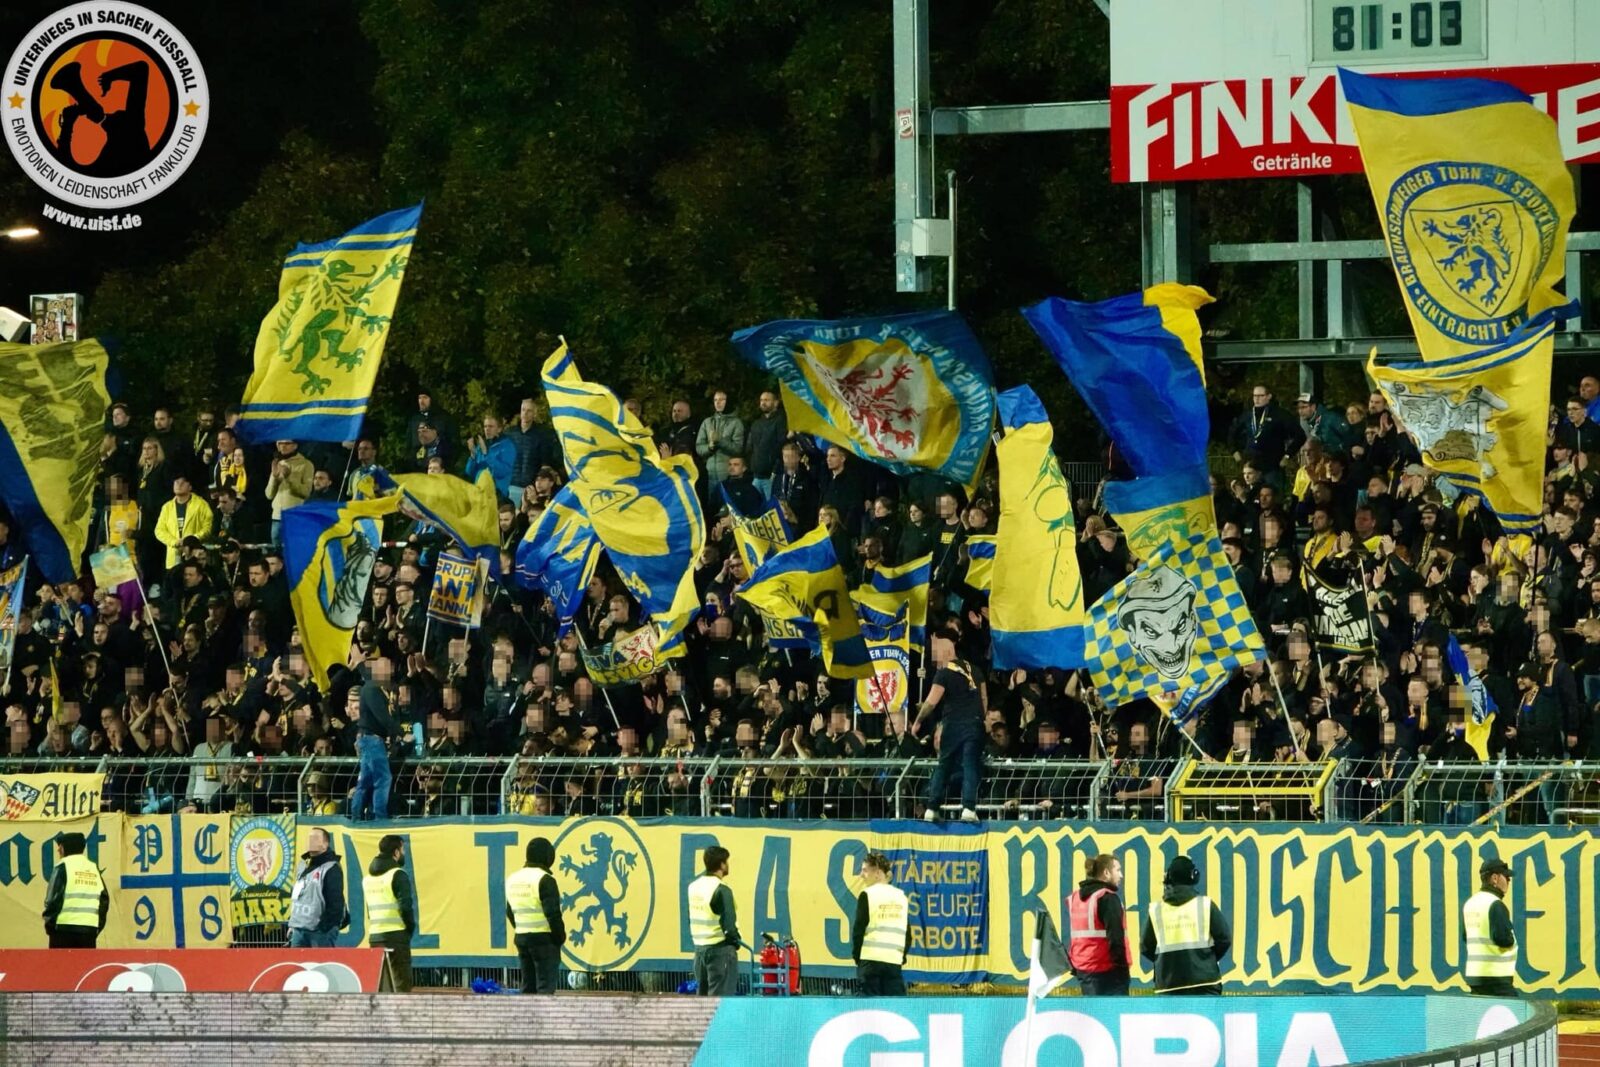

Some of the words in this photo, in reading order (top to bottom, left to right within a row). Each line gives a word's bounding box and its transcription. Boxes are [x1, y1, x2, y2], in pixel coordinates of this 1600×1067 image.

[1332, 1, 1462, 52] 81:03
[1252, 152, 1332, 172] Getränke
[1416, 294, 1499, 340] EINTRACHT
[41, 782, 99, 818] Aller
[891, 854, 980, 884] TÄRKER
[134, 896, 156, 941] 9
[199, 896, 222, 941] 8
[927, 893, 983, 918] EURE
[909, 924, 982, 950] RBOTE
